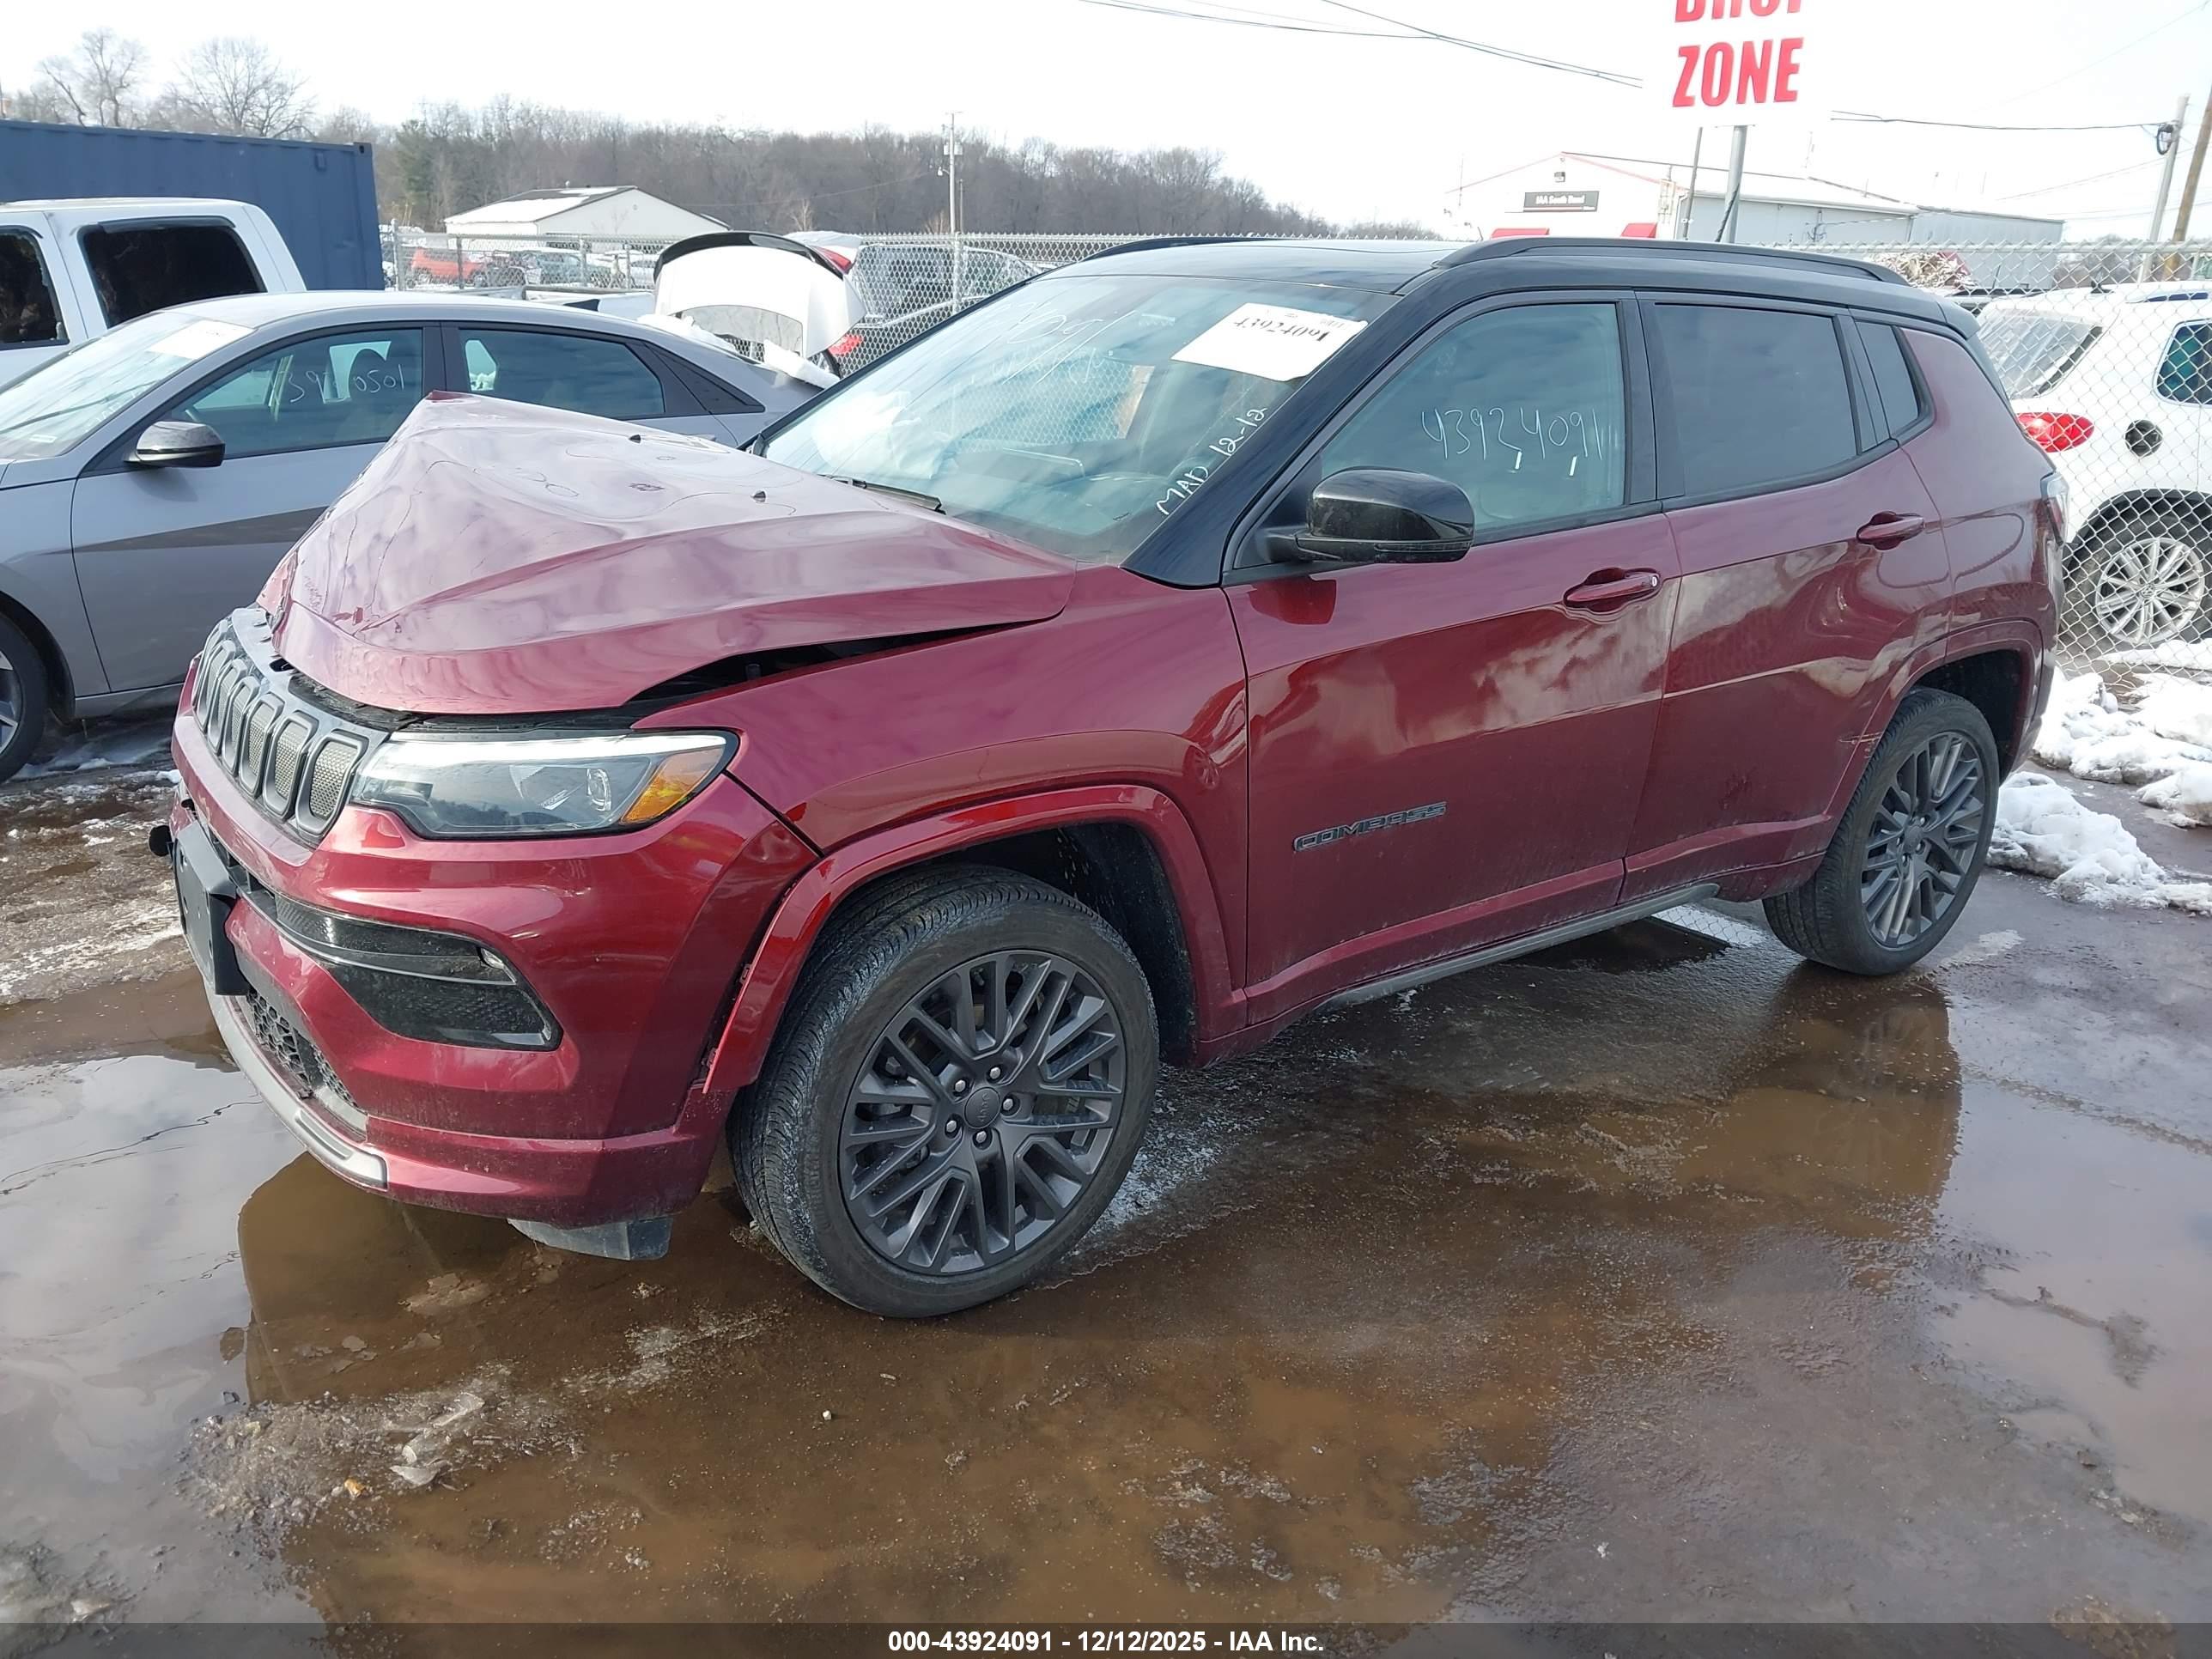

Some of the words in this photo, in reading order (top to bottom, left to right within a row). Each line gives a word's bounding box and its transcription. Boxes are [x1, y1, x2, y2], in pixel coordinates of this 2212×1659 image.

[1672, 37, 1804, 107] ZONE
[1421, 406, 1602, 461] 43924091
[1292, 801, 1447, 852] COMPASS
